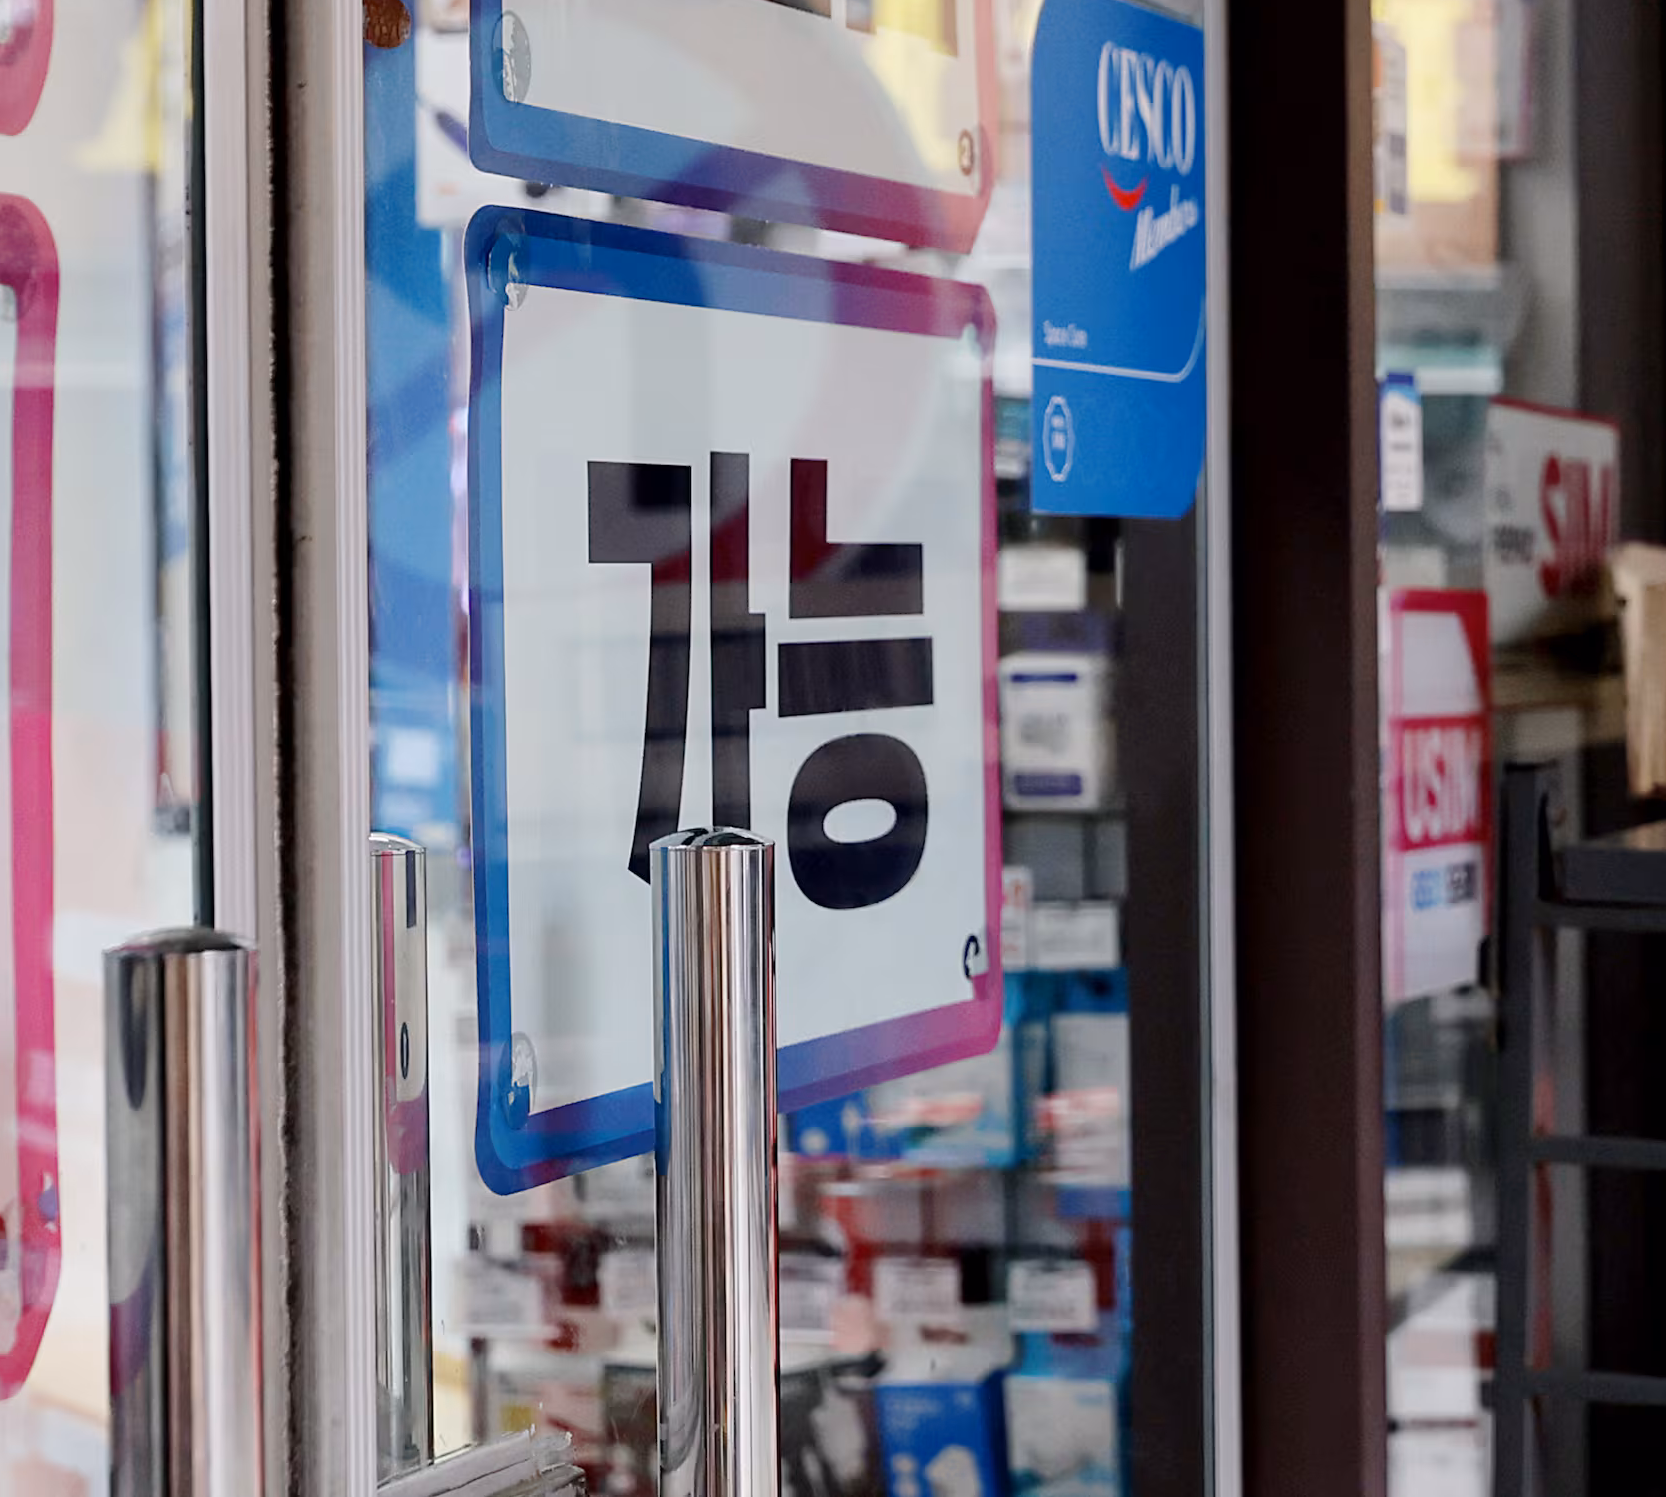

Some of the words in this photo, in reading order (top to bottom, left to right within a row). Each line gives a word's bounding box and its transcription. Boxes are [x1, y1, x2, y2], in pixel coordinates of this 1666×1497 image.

[1097, 40, 1196, 176] CESCO
[587, 451, 934, 911] 가능
[1402, 727, 1483, 843] USIM
